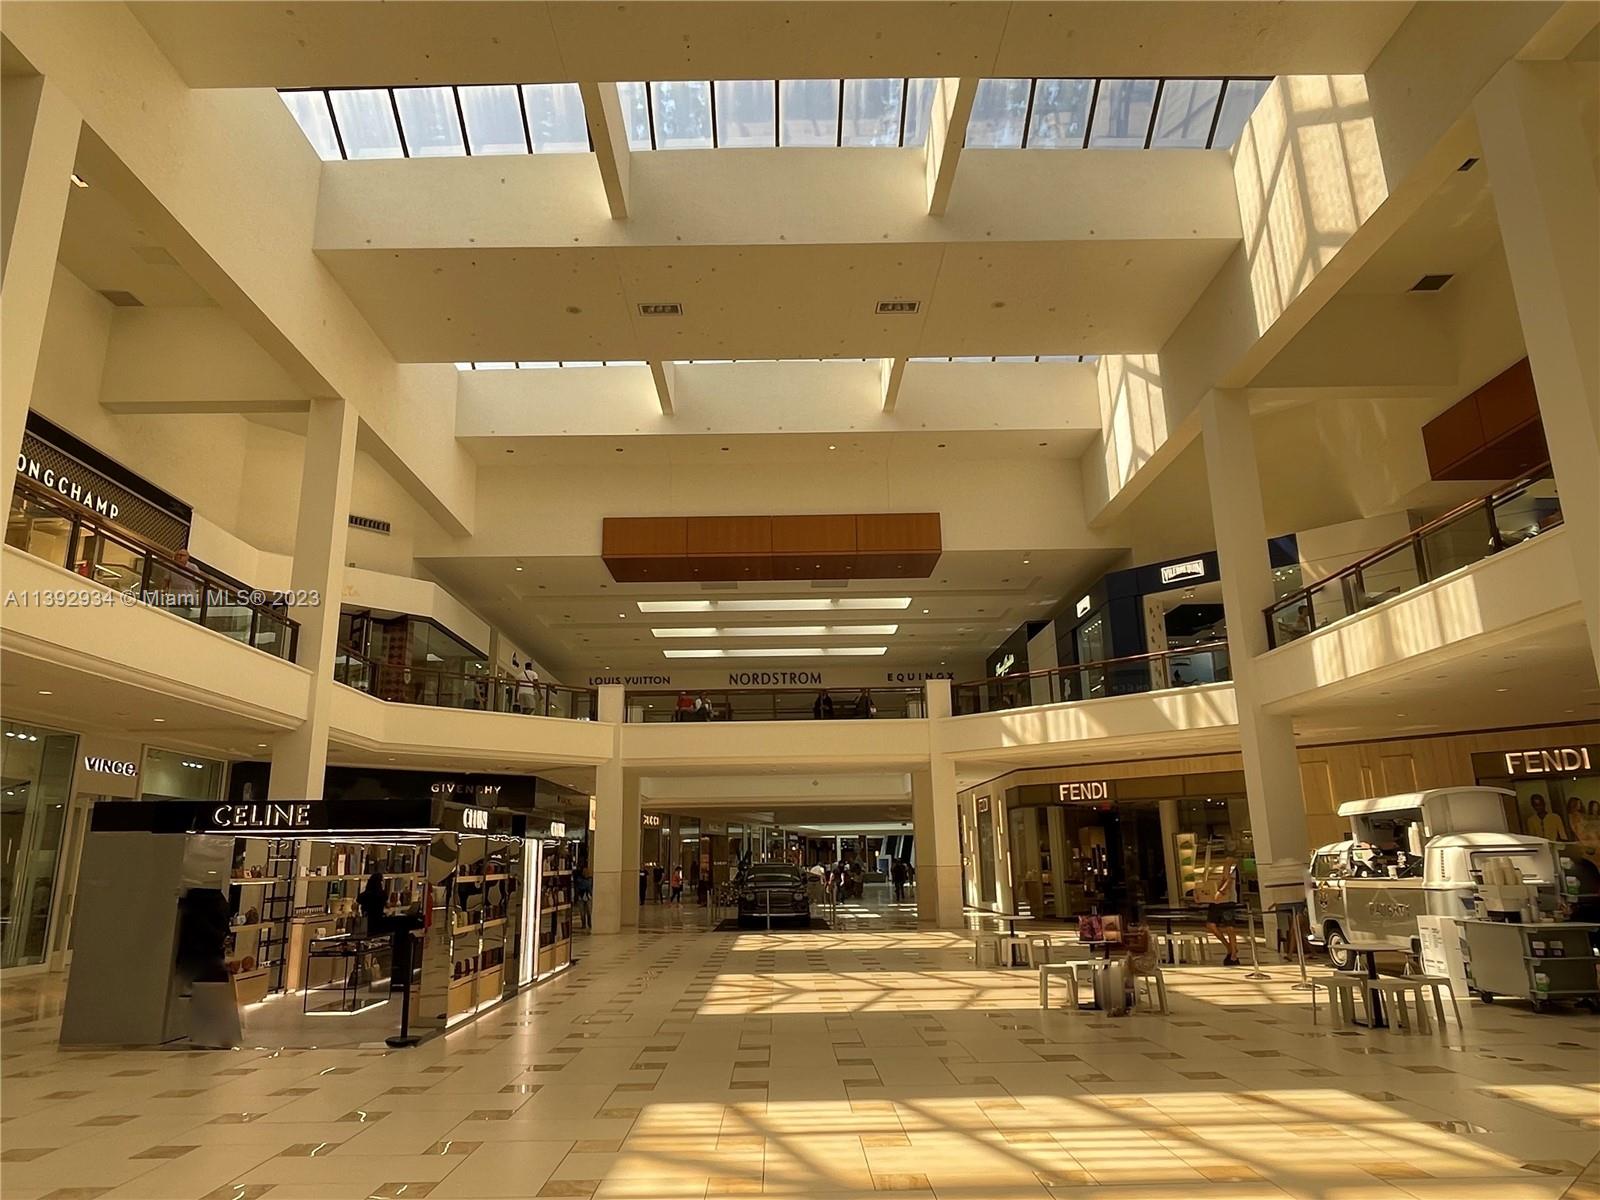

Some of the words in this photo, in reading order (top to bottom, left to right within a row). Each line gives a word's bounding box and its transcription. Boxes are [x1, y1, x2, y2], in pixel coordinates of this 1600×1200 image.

[16, 453, 119, 519] ONGCHAMP
[589, 676, 621, 686] LOUIS
[624, 676, 671, 685] VUITTON
[729, 672, 822, 685] NORDSTROM
[887, 672, 954, 682] EQUINOX
[1505, 747, 1591, 774] FENDI
[1059, 781, 1107, 801] FENDI
[212, 804, 310, 826] CELINE
